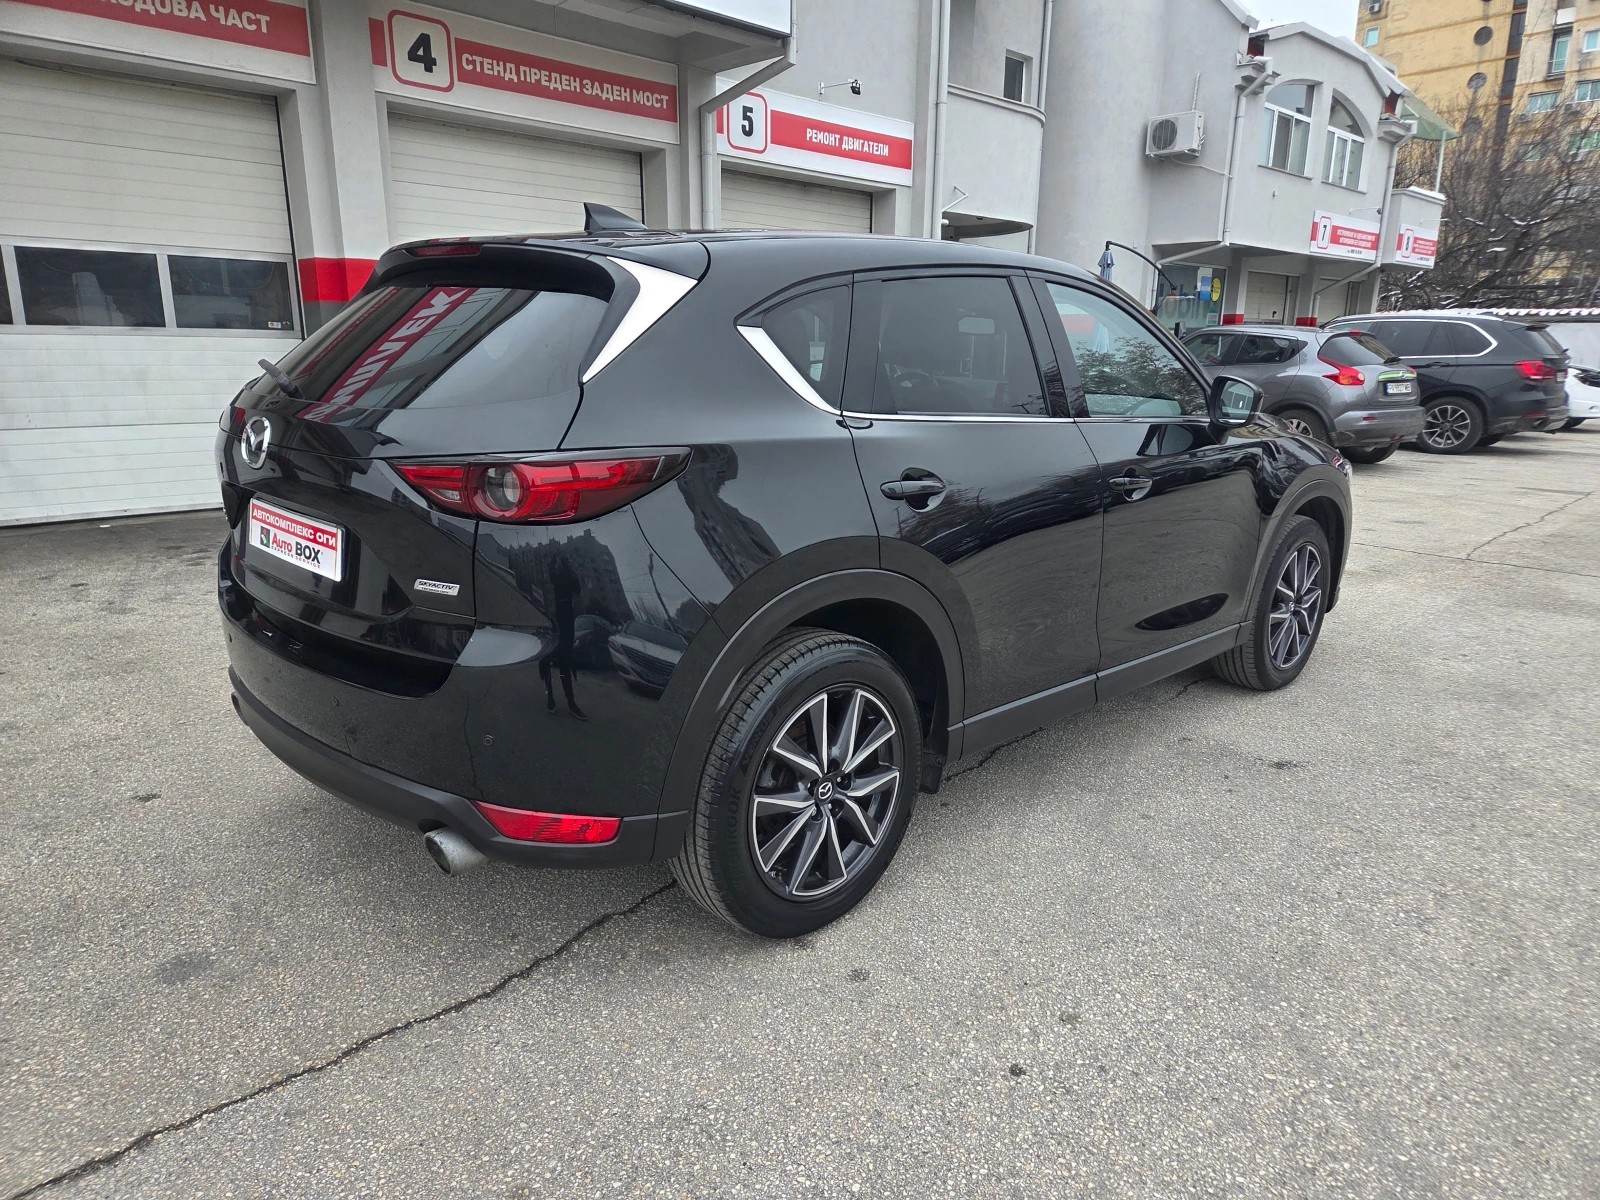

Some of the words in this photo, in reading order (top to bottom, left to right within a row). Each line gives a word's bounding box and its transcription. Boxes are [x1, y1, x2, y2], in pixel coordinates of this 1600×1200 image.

[209, 4, 270, 33] ЧАСТ
[407, 32, 437, 74] 4
[461, 53, 517, 82] СТЕНД
[520, 66, 581, 92] ПРЕДЕН
[583, 79, 631, 102] ЗАДЕН
[632, 89, 669, 109] МОСТ
[741, 105, 754, 137] 5
[806, 128, 840, 147] РЕМОНТ
[842, 136, 889, 157] ДВИГАТЕЛИ
[1322, 224, 1328, 241] 7
[253, 508, 314, 539] АВТОКОМПЛЕКС
[316, 532, 336, 547] ОГИ
[271, 546, 294, 559] EXPRESS
[295, 555, 321, 569] SERVICE
[295, 541, 321, 564] BOX
[418, 580, 455, 590] SKYACTIV
